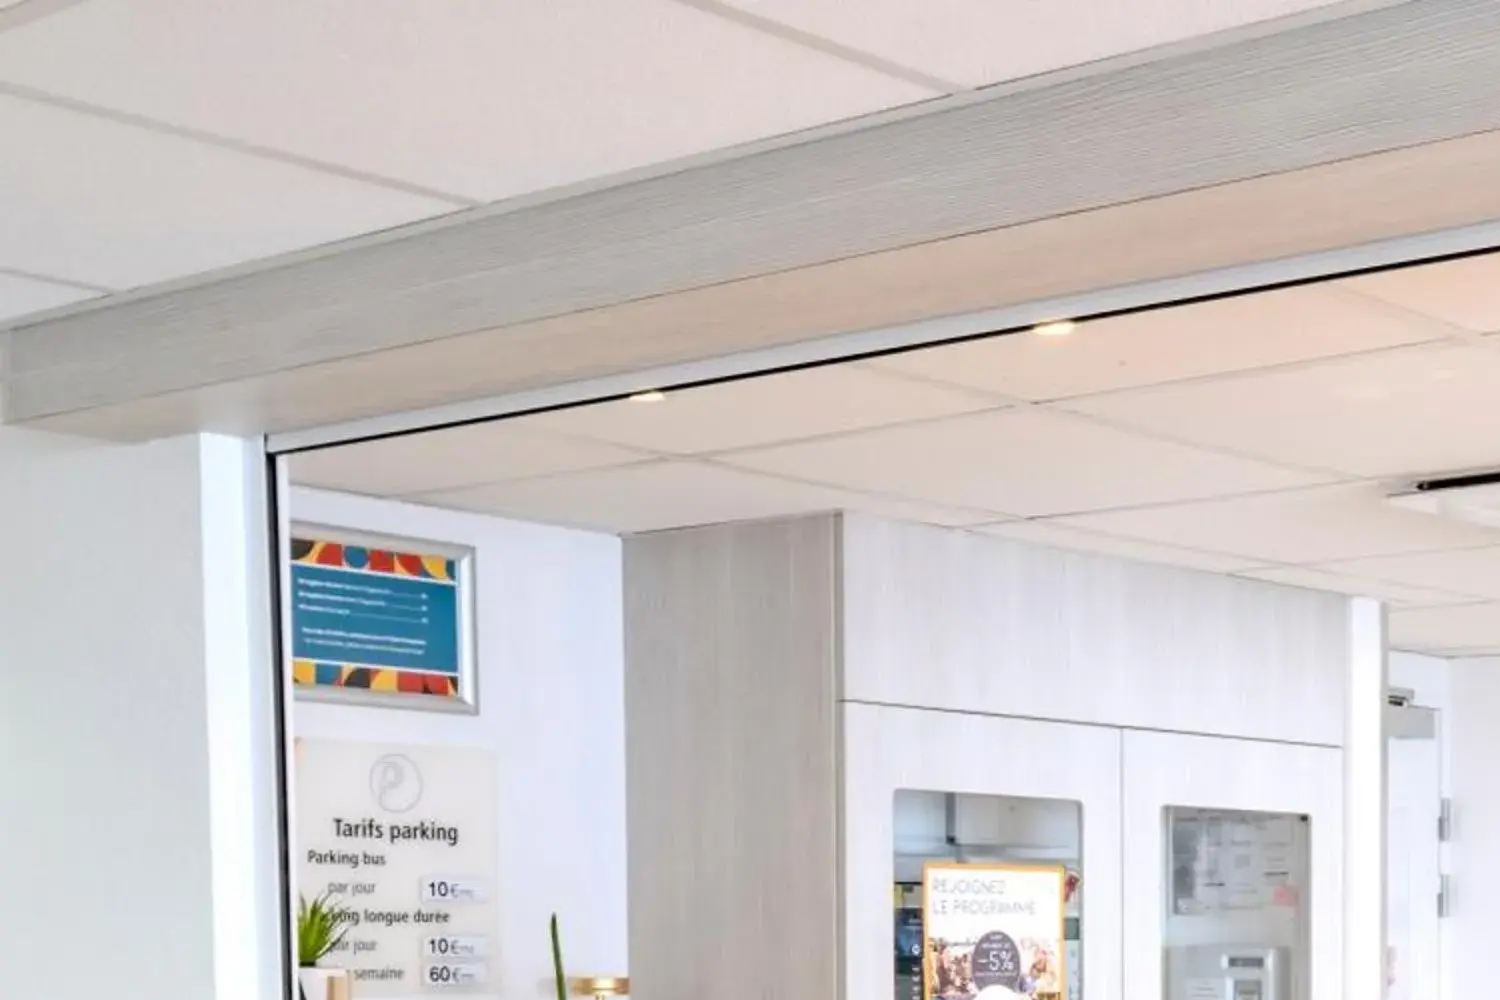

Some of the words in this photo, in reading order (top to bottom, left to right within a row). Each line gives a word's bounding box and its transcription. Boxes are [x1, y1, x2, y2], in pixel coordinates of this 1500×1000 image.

[333, 818, 384, 839] Tarifs
[389, 821, 458, 846] parking
[307, 849, 359, 869] Parking
[362, 851, 386, 866] bus
[327, 882, 348, 895] par
[352, 883, 376, 897] jour
[932, 876, 1006, 895] REJOIGNEZ
[932, 899, 949, 915] LE
[953, 899, 1036, 915] PROGRAMME
[364, 908, 408, 927] longue
[353, 941, 378, 956] jour
[353, 967, 405, 980] semaine
